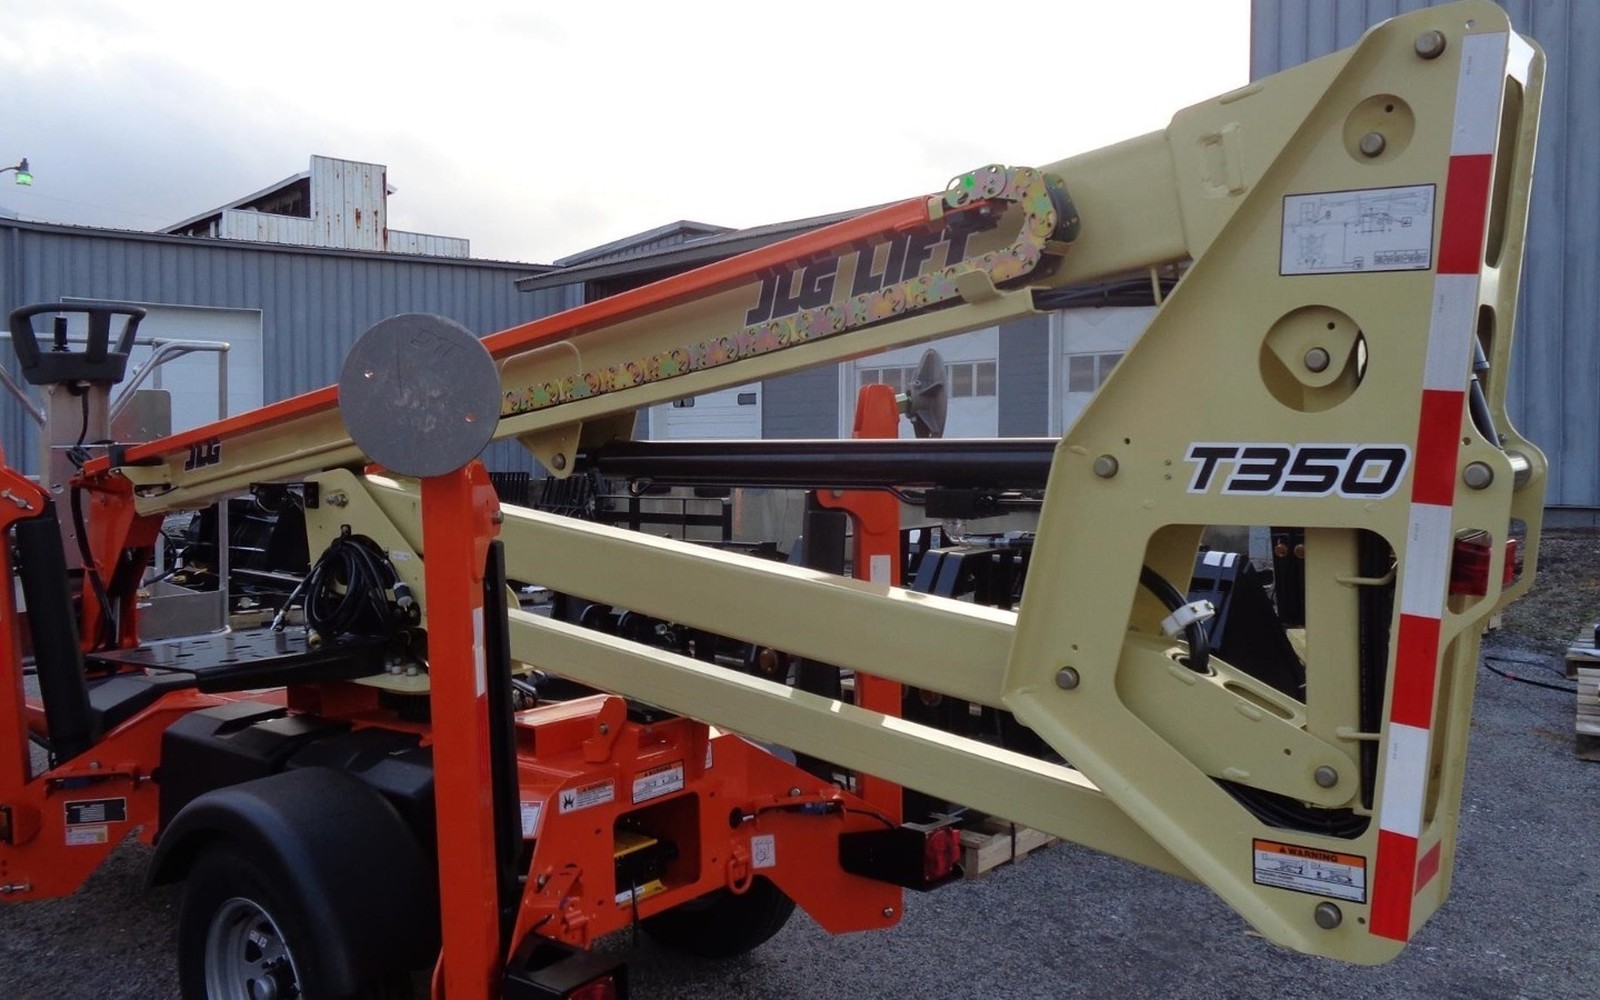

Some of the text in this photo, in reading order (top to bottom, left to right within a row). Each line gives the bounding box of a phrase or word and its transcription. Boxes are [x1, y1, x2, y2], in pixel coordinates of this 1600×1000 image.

[744, 214, 998, 326] JLG LIFT
[184, 440, 221, 471] JLG
[1188, 446, 1408, 495] T350
[1288, 847, 1339, 863] WARNING
